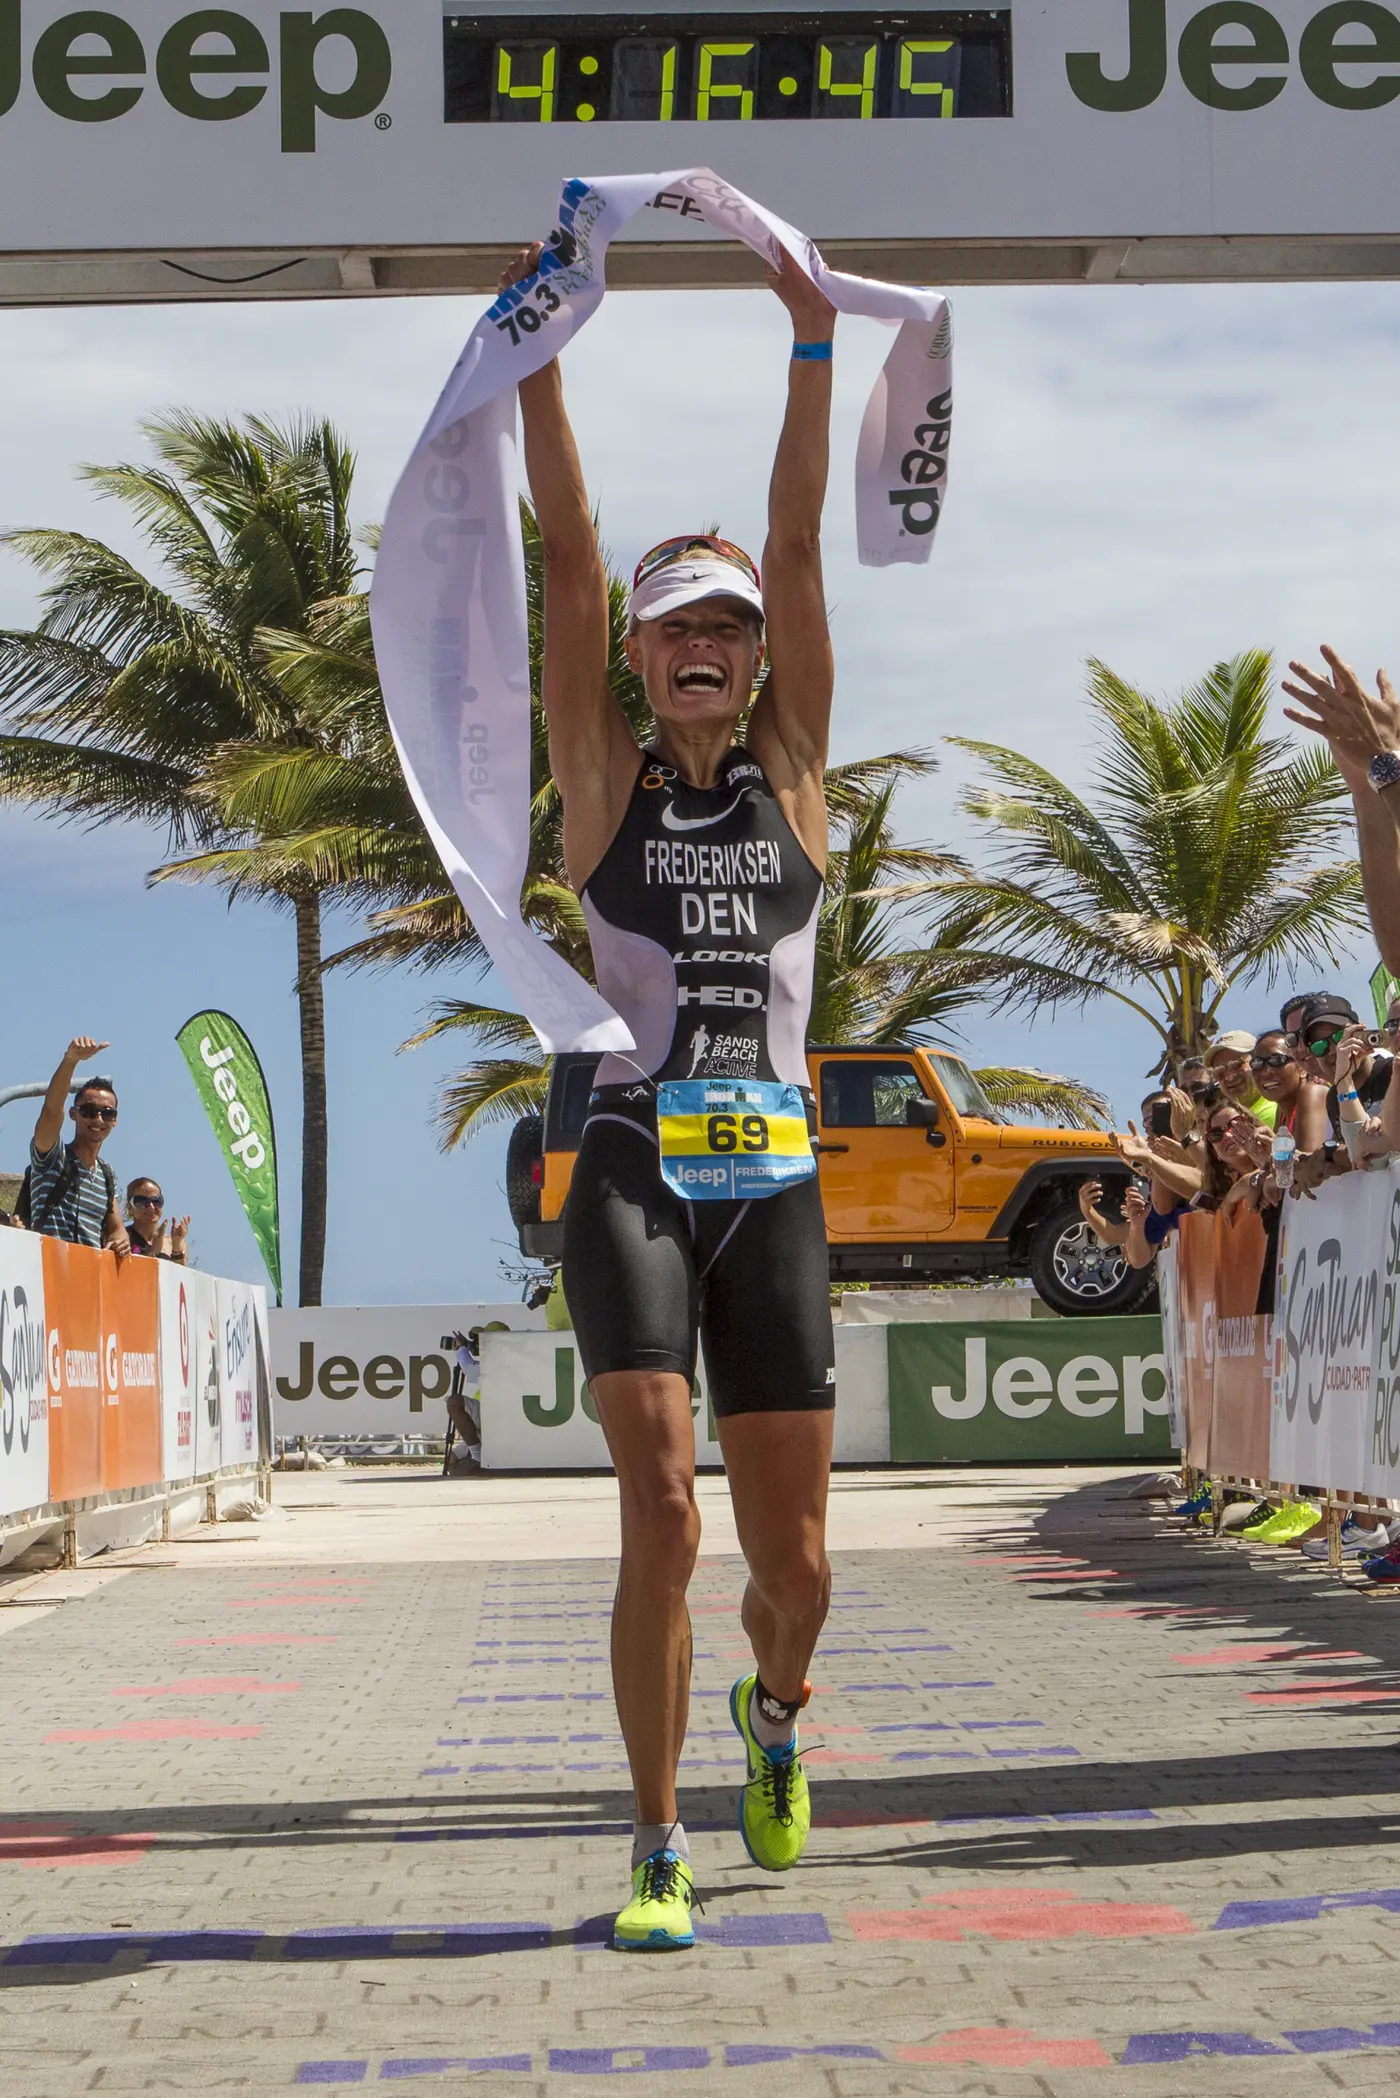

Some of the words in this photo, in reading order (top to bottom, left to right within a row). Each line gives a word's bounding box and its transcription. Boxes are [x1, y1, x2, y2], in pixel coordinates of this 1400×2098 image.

[496, 283, 560, 347] 70.3
[644, 839, 782, 886] FREDERIKSEN
[681, 892, 759, 936] DEN
[672, 950, 770, 966] LOOK
[711, 1046, 758, 1062] BEACH
[714, 1033, 760, 1052] SANDS
[704, 1057, 758, 1080] ACTIVE
[706, 1081, 732, 1092] Jeep
[199, 1035, 266, 1170] Jeep
[705, 1103, 729, 1113] 70.3
[707, 1114, 769, 1153] 69
[1032, 1139, 1115, 1148] RUBICON
[672, 1164, 728, 1187] Jeep
[275, 1341, 453, 1413] Jeep
[931, 1337, 1168, 1435] Jeep
